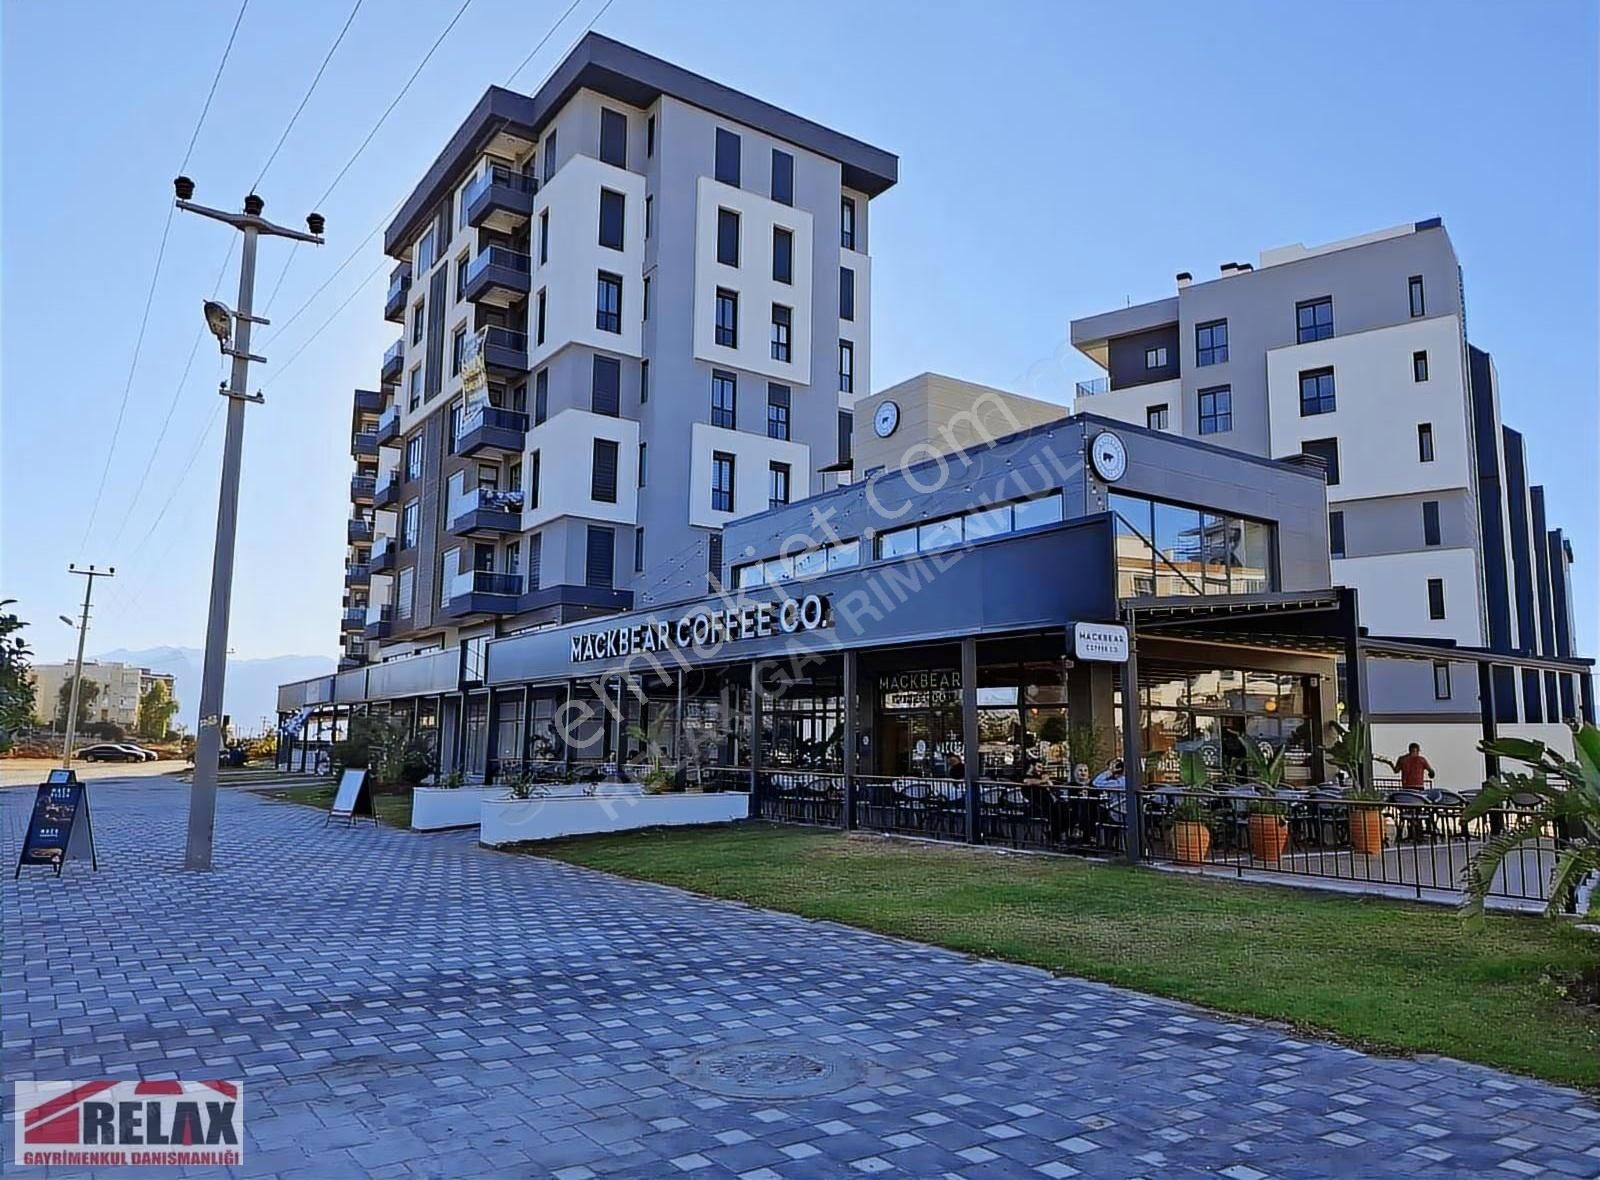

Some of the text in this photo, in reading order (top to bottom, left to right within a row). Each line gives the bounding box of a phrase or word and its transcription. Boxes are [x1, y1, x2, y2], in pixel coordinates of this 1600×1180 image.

[569, 594, 828, 662] MACKBEAR COFFEE CO.
[1079, 631, 1124, 643] MACKBEAR
[879, 671, 962, 690] MACKBEAR
